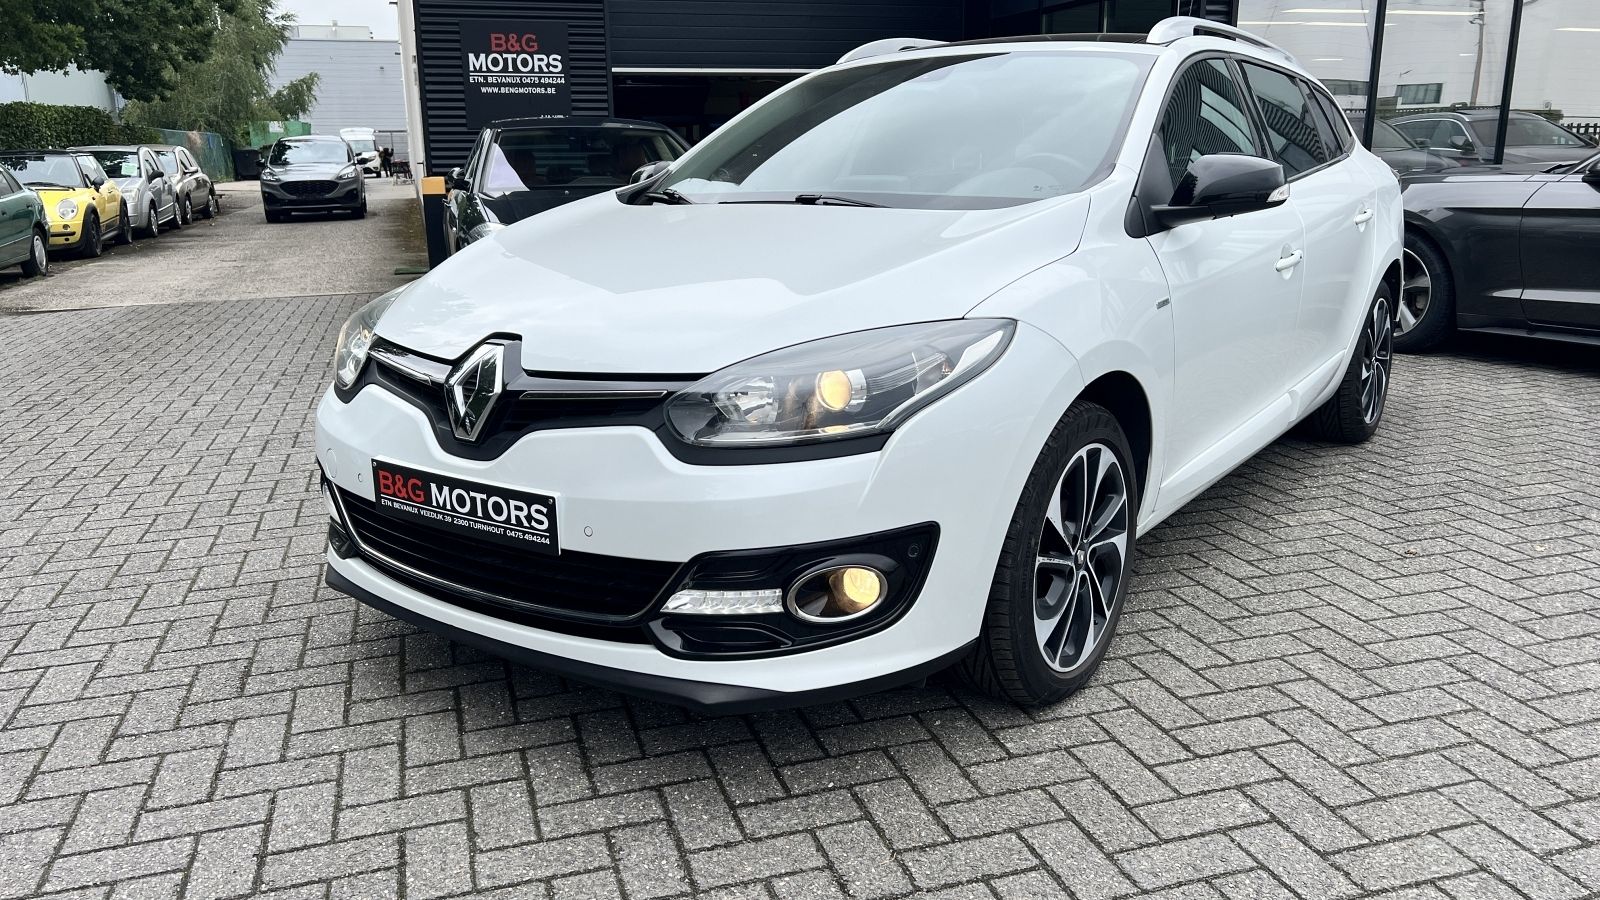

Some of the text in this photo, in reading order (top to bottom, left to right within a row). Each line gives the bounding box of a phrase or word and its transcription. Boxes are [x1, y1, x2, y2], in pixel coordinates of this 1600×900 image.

[490, 33, 538, 52] B&G
[468, 53, 563, 72] MOTORS
[378, 470, 549, 531] B&G MOTORS
[393, 502, 419, 514] BEVANUX
[444, 515, 452, 523] 39
[453, 518, 469, 527] 2300
[470, 521, 505, 535] TURNHOUT
[506, 530, 524, 539] 0475
[524, 533, 550, 545] 494244
